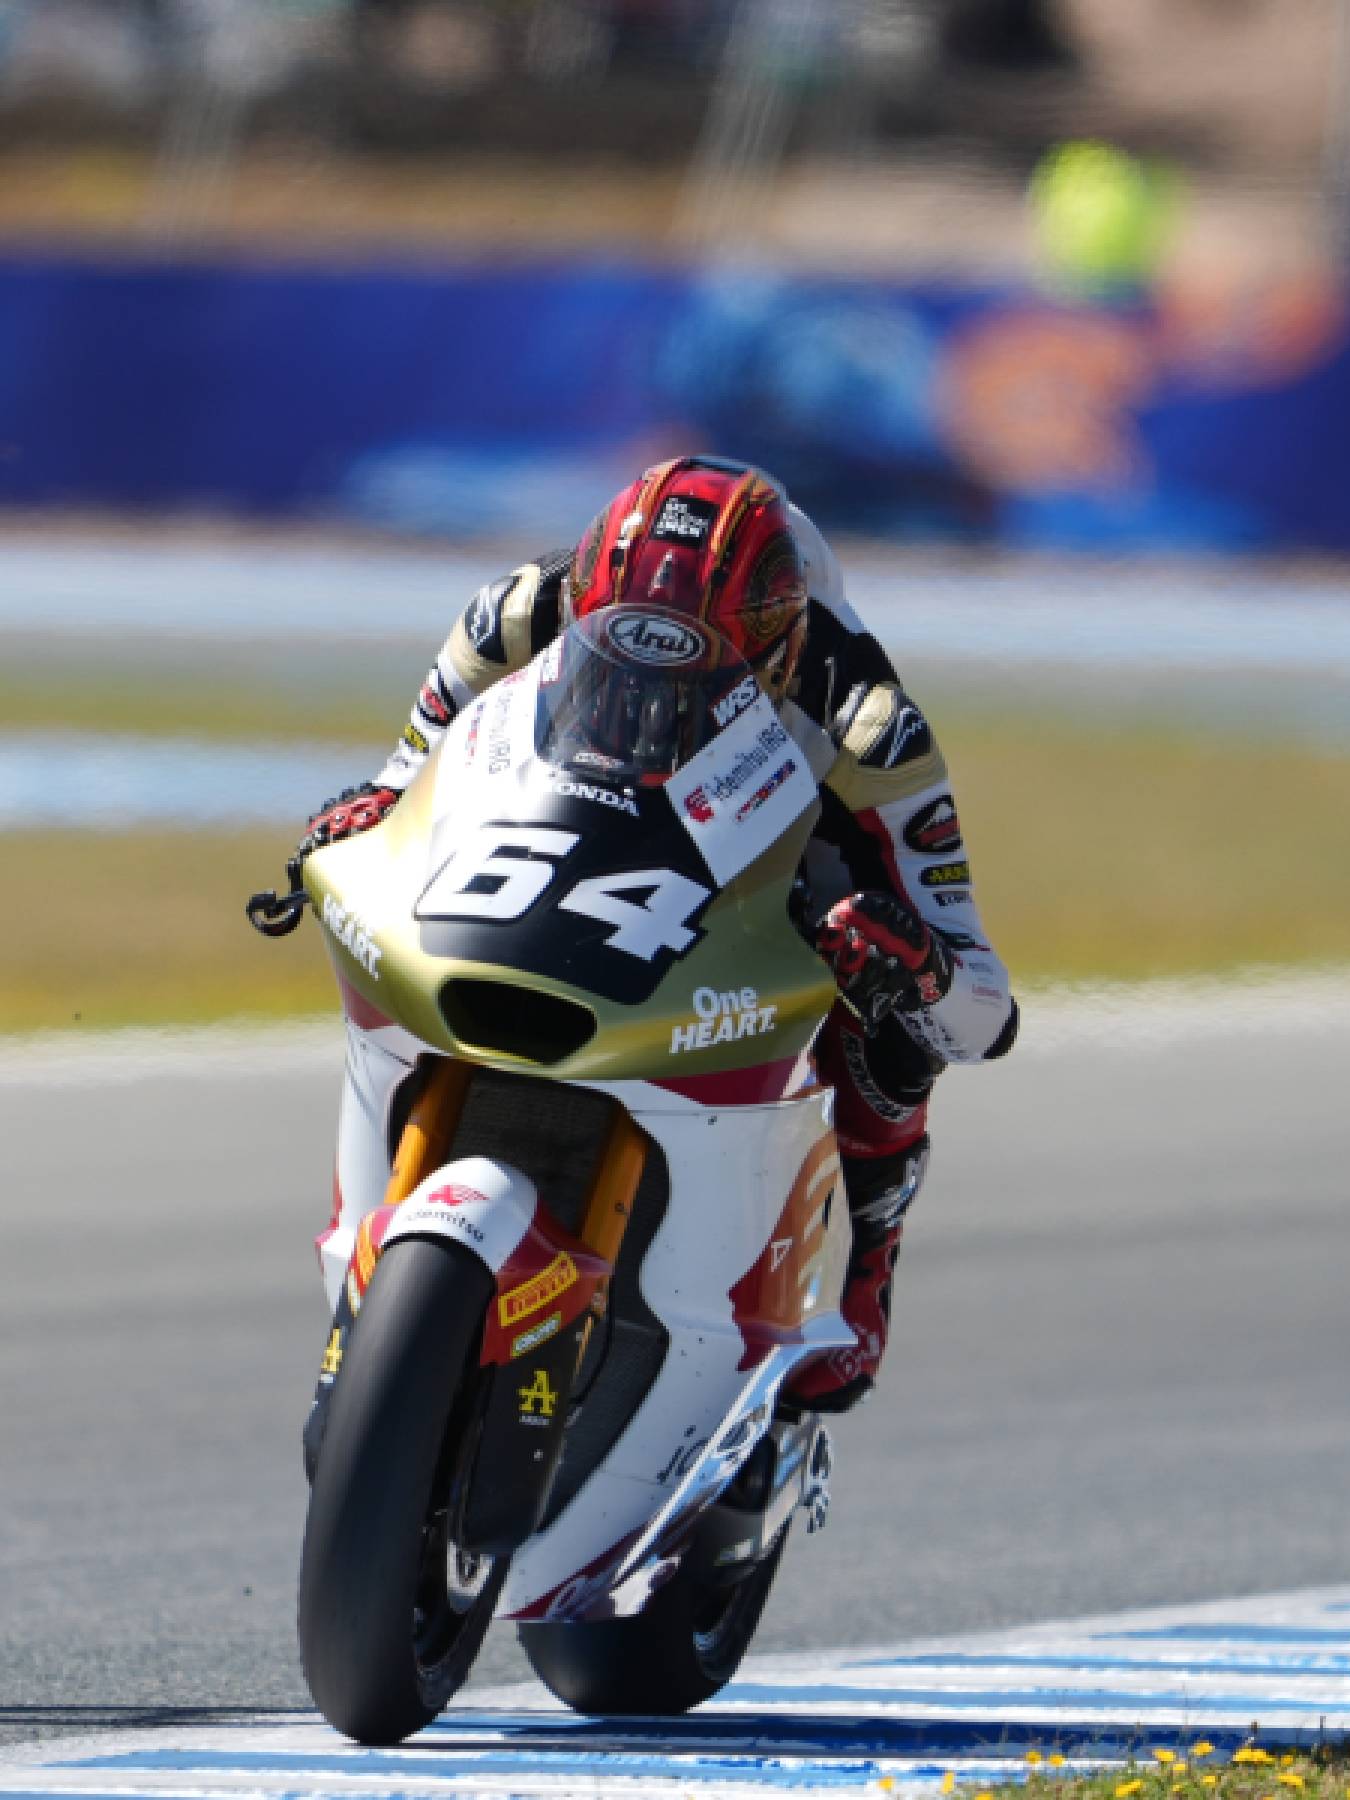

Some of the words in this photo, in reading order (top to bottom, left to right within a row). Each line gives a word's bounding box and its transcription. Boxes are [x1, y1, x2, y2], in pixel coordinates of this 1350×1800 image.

[623, 618, 689, 652] Arai
[414, 828, 712, 961] 64
[693, 986, 758, 1019] One
